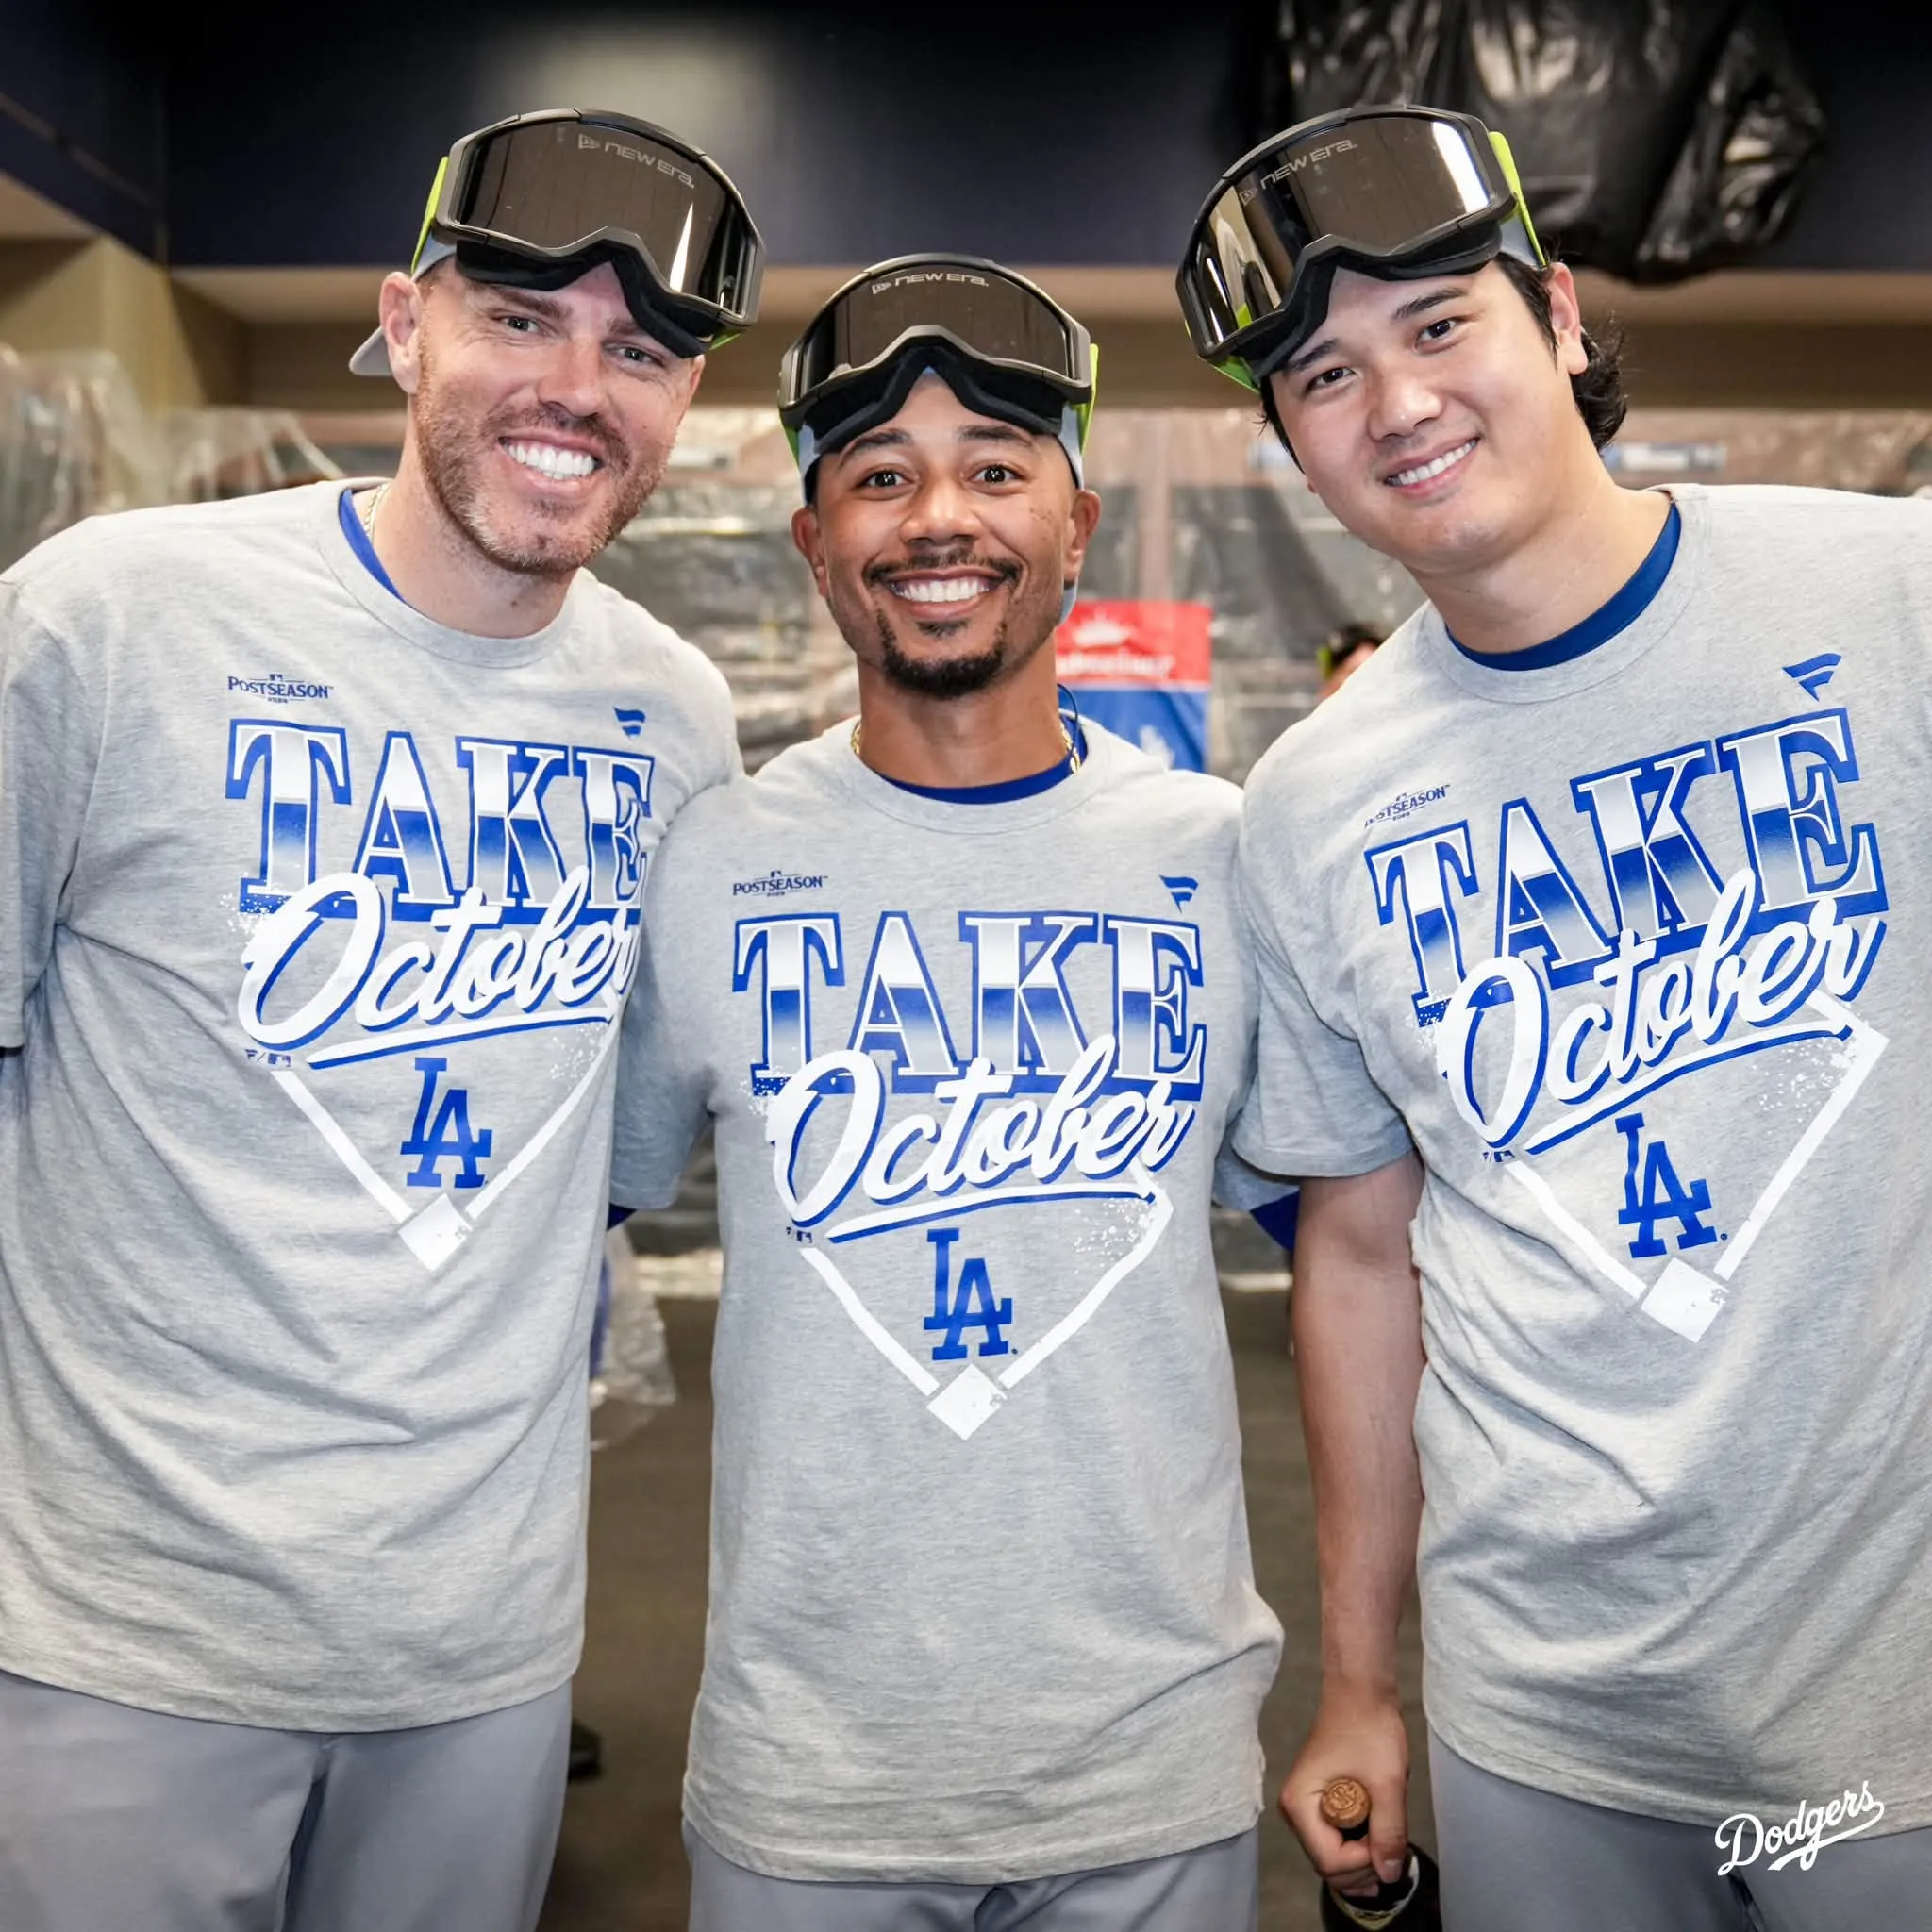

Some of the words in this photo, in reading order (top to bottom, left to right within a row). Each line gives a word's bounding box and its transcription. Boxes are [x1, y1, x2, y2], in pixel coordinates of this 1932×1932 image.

[227, 675, 329, 699] POSTSEASON
[225, 718, 655, 925] TAKE
[732, 875, 823, 895] POSTSEASON
[1364, 707, 1890, 1028] TAKE
[238, 864, 639, 1050] October
[732, 910, 1207, 1102] TAKE
[1437, 867, 1888, 1148] October
[400, 1058, 492, 1189] LA
[765, 1034, 1196, 1225] October
[1614, 1111, 1719, 1259] LA
[924, 1228, 1012, 1360] LA
